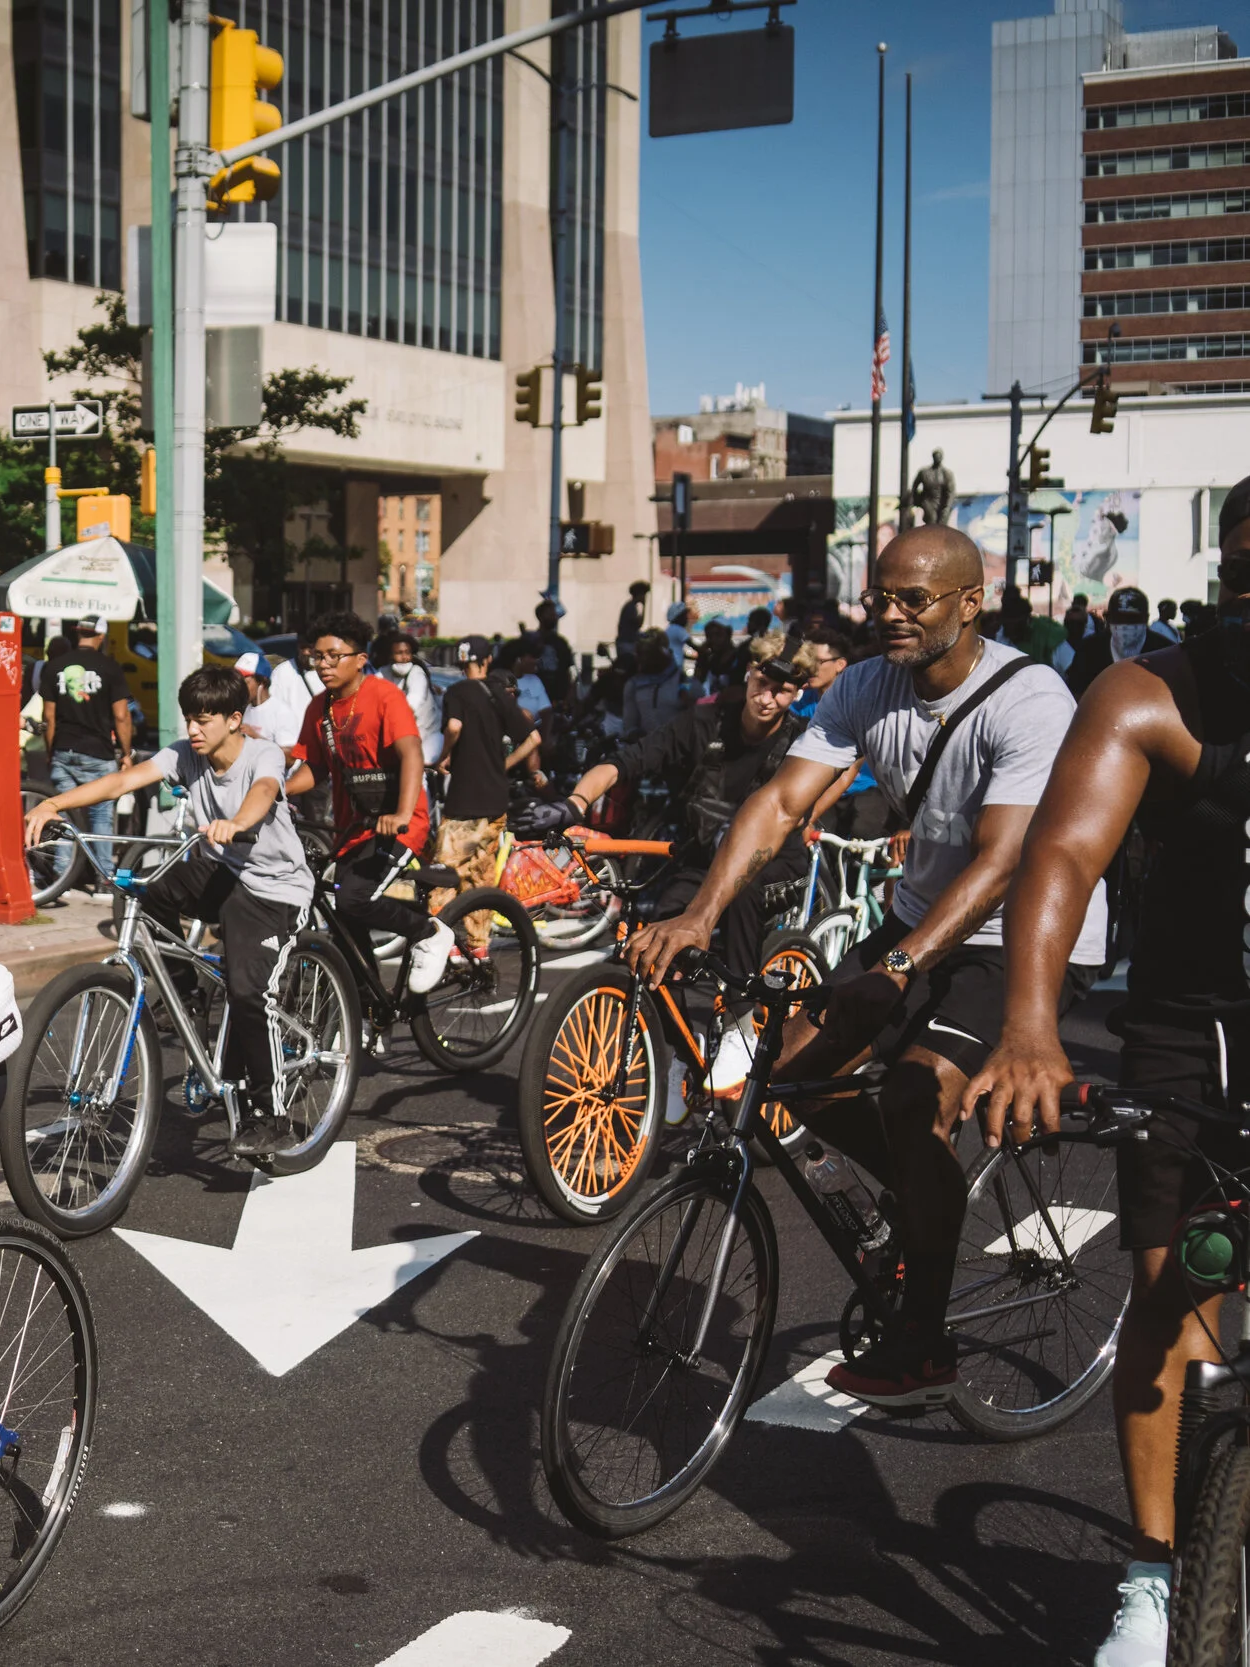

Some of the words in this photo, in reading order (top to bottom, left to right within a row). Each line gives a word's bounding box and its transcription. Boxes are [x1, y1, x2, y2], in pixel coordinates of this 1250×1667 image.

[19, 413, 44, 427] ONE
[60, 412, 86, 425] WAY
[25, 594, 62, 608] Catch
[65, 597, 84, 609] the
[67, 1445, 90, 1513] BONTRAGER
